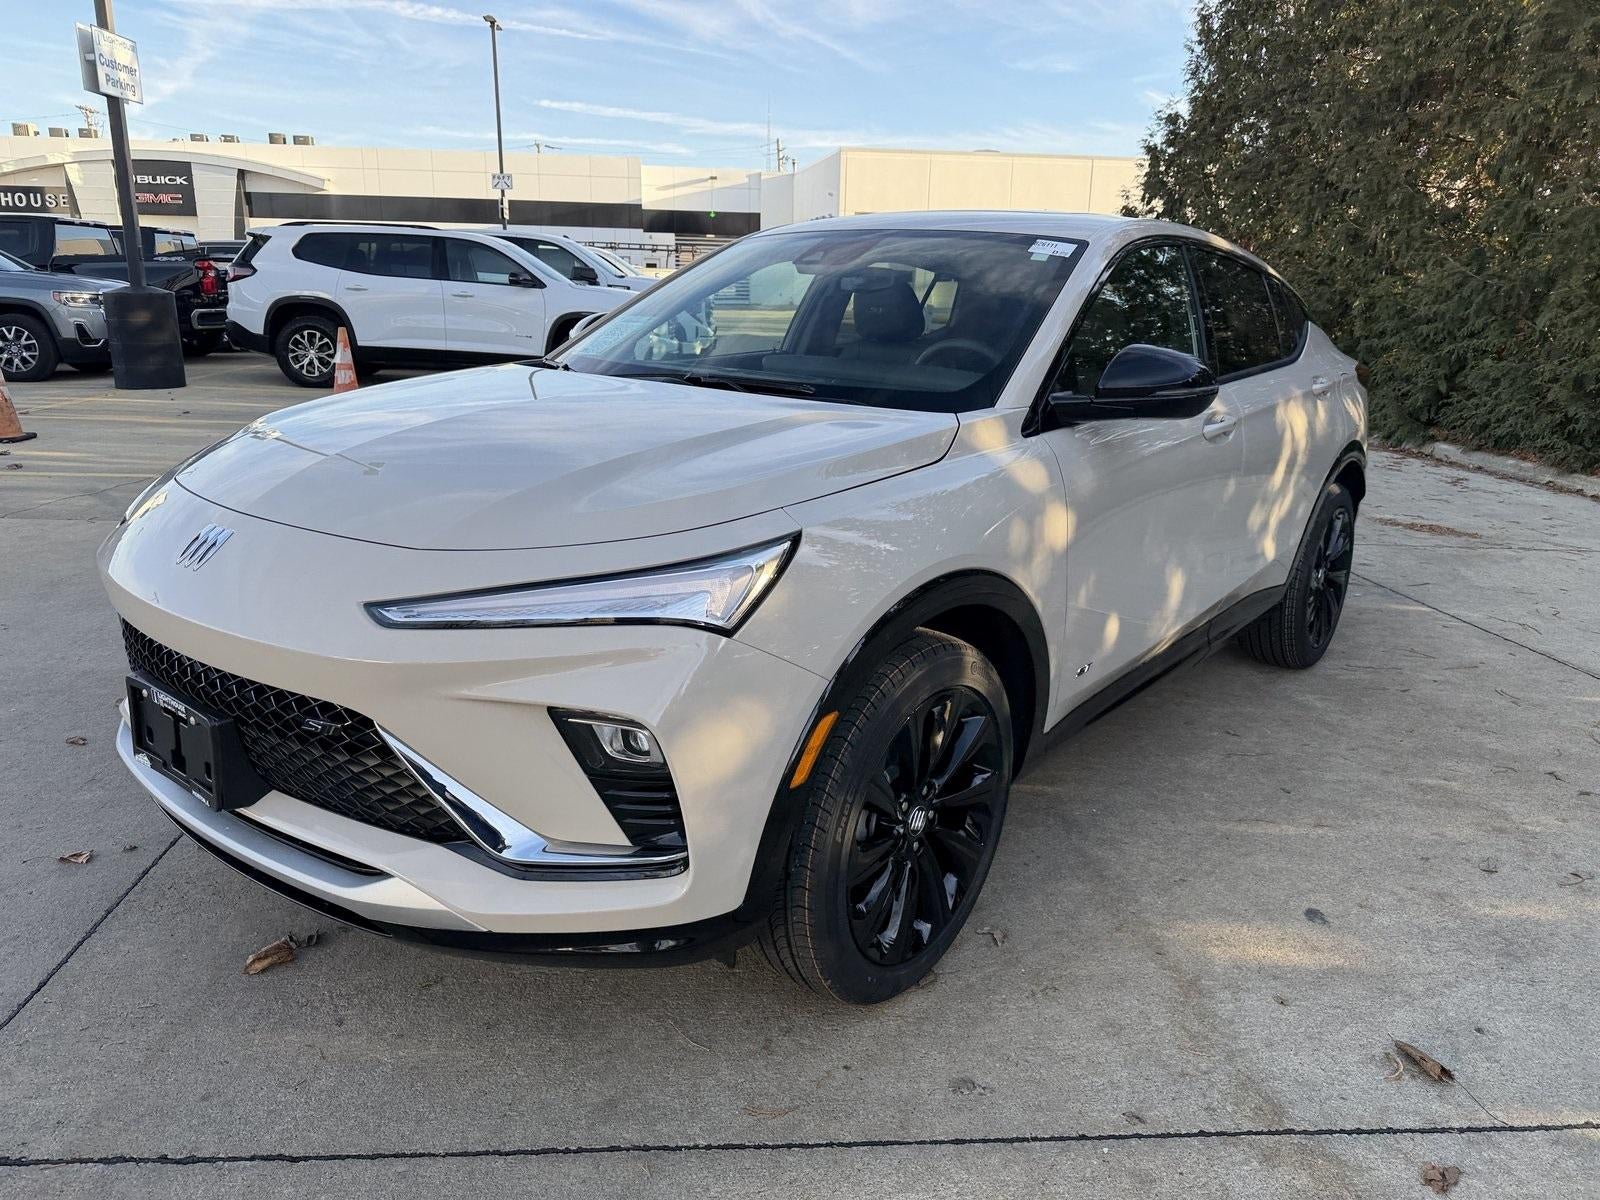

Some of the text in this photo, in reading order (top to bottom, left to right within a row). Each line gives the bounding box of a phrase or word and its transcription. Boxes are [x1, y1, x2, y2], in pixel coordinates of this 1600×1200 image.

[98, 53, 137, 77] Customer
[105, 73, 137, 97] Parking
[136, 174, 189, 185] BUICK
[0, 191, 70, 208] HOUSE
[135, 193, 183, 204] GMC
